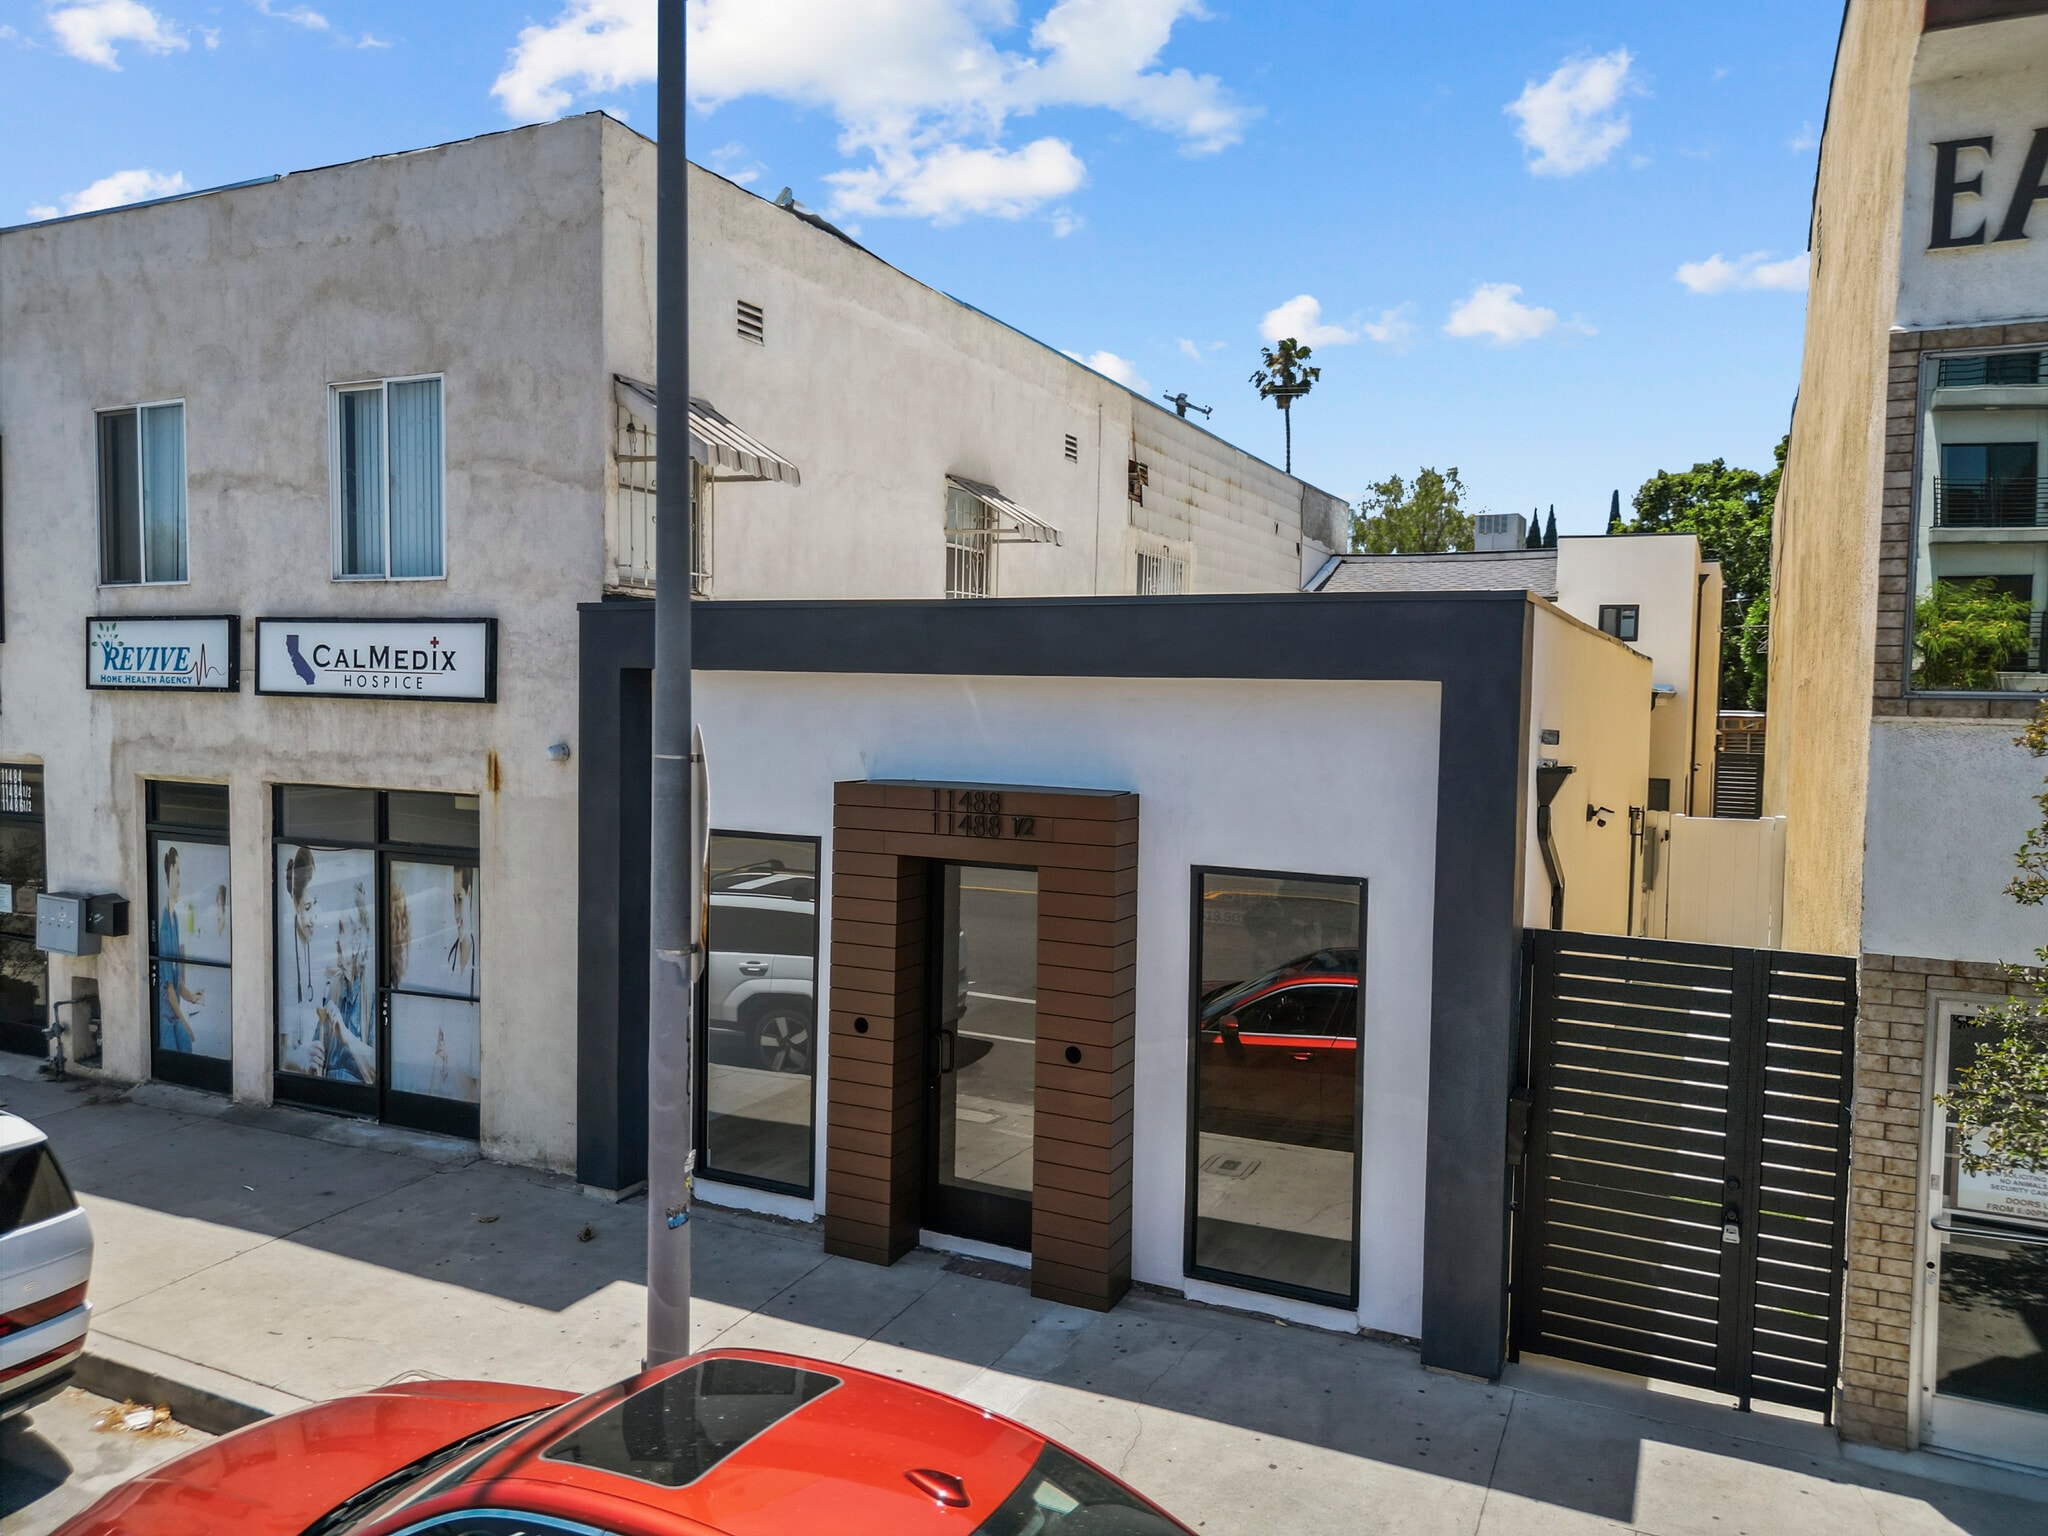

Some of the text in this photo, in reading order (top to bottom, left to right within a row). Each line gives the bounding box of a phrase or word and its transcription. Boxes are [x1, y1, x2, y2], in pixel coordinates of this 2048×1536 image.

[1926, 127, 2048, 250] EA
[103, 645, 190, 672] REVIVE
[101, 674, 192, 685] HOME HEALTH AGENCY
[344, 674, 423, 690] HOSPICE
[932, 788, 1001, 814] 11488
[932, 812, 1001, 838] 11488
[1990, 1184, 2028, 1193] SECURITY
[2013, 1180, 2048, 1189] ANIMALS
[1986, 1203, 2014, 1212] FROM
[2006, 1197, 2040, 1207] DOORS
